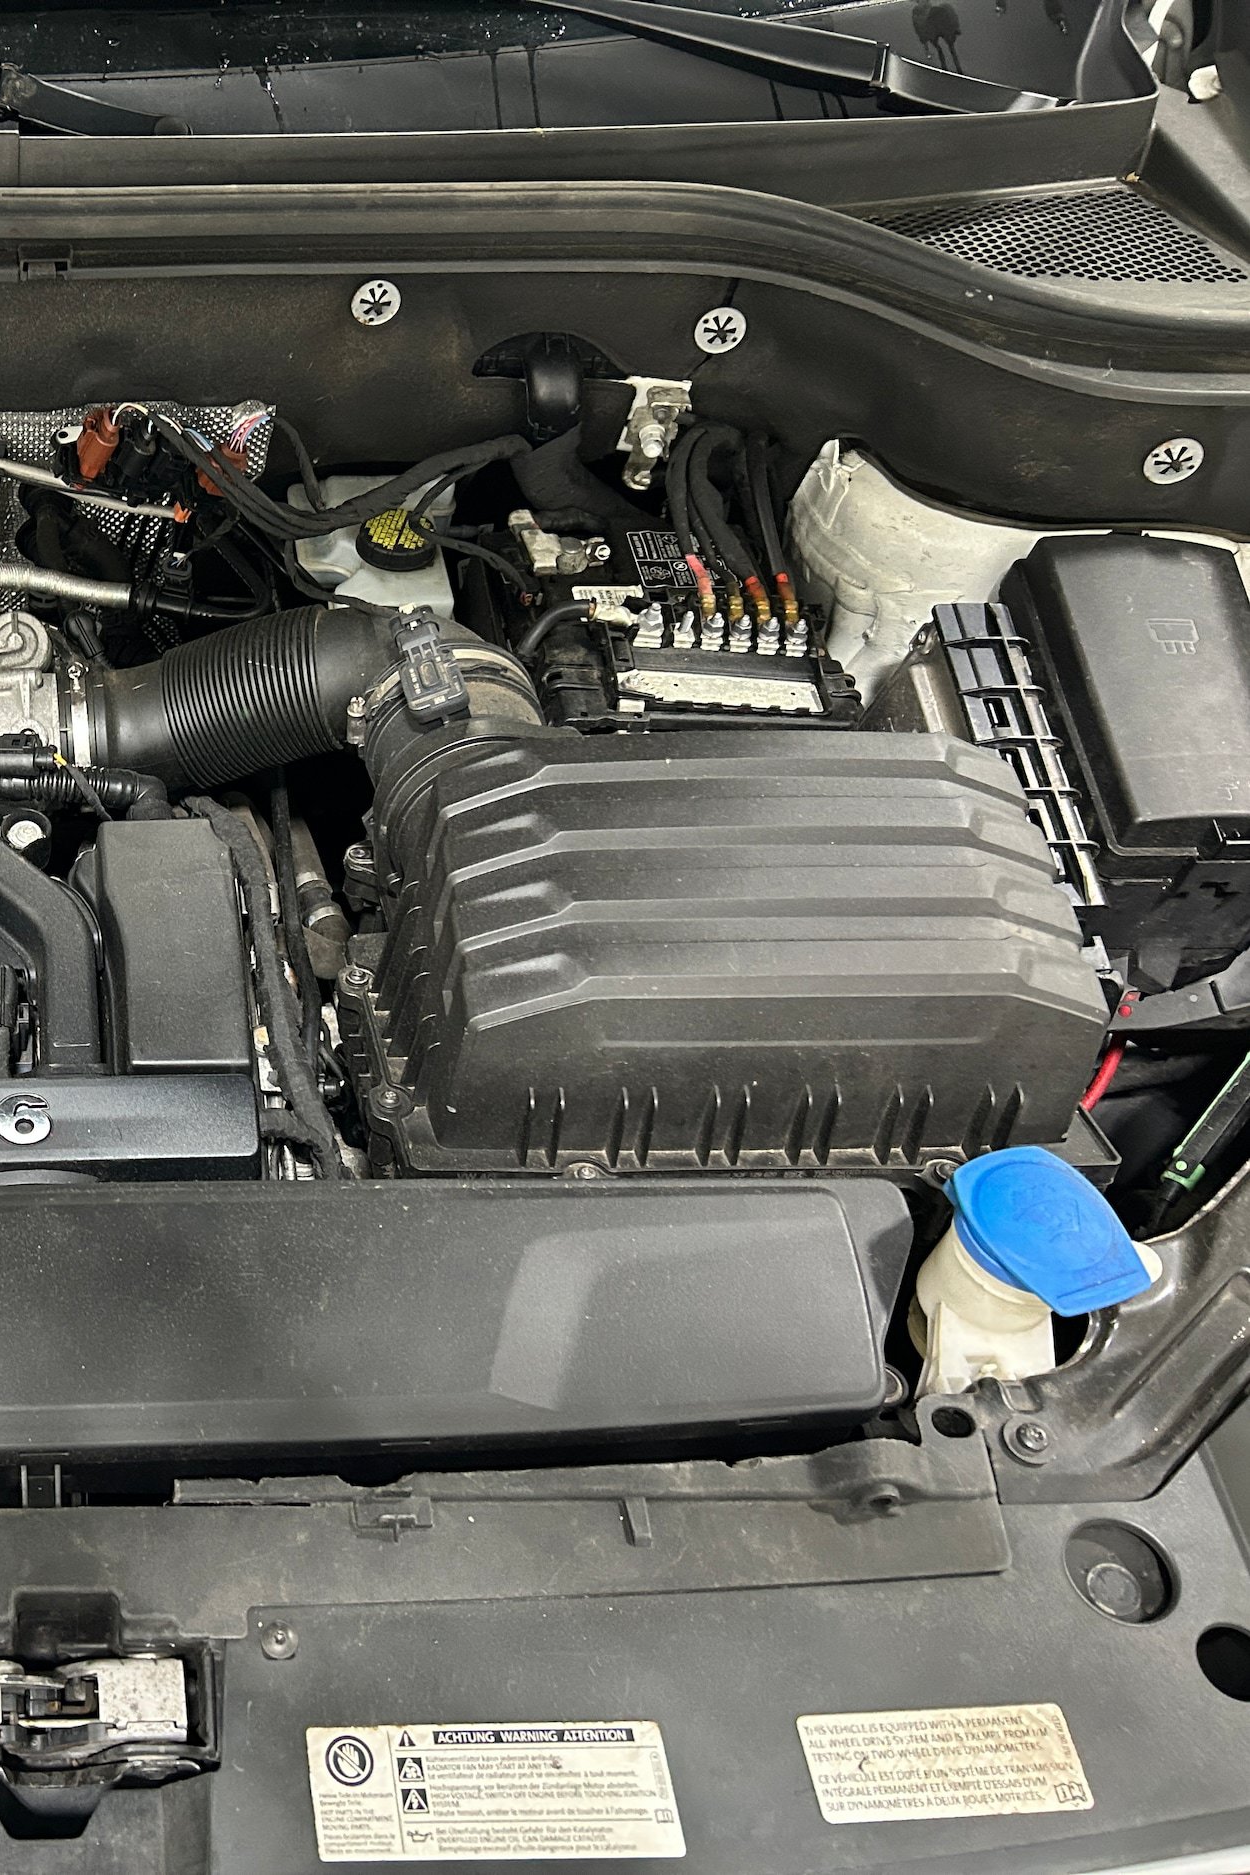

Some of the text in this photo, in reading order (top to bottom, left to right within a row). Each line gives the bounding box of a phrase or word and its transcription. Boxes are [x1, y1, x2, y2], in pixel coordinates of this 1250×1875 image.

[804, 1715, 1023, 1735] THIS VEHICLE IS EQUIPPED WITH A PERMANENT
[437, 1730, 628, 1743] ACHTUNG WARNING ATTENTION
[862, 1735, 892, 1747] DRIVE
[893, 1734, 929, 1745] SYSTEM
[931, 1732, 953, 1743] AND
[954, 1731, 964, 1742] IS
[965, 1730, 1001, 1741] EXEMPT
[1004, 1728, 1031, 1739] FROM
[812, 1750, 852, 1762] TESTING
[853, 1749, 869, 1760] ON
[933, 1746, 963, 1757] DRIVE
[818, 1774, 830, 1784] CE
[879, 1770, 895, 1781] EST
[990, 1765, 1005, 1775] DE
[1005, 1761, 1074, 1775] TRANSMISSION
[873, 1783, 928, 1795] PERMANENT
[930, 1782, 941, 1792] ET
[826, 1801, 845, 1812] SUR
[934, 1795, 961, 1806] DEUX
[963, 1793, 994, 1805] ROUES
